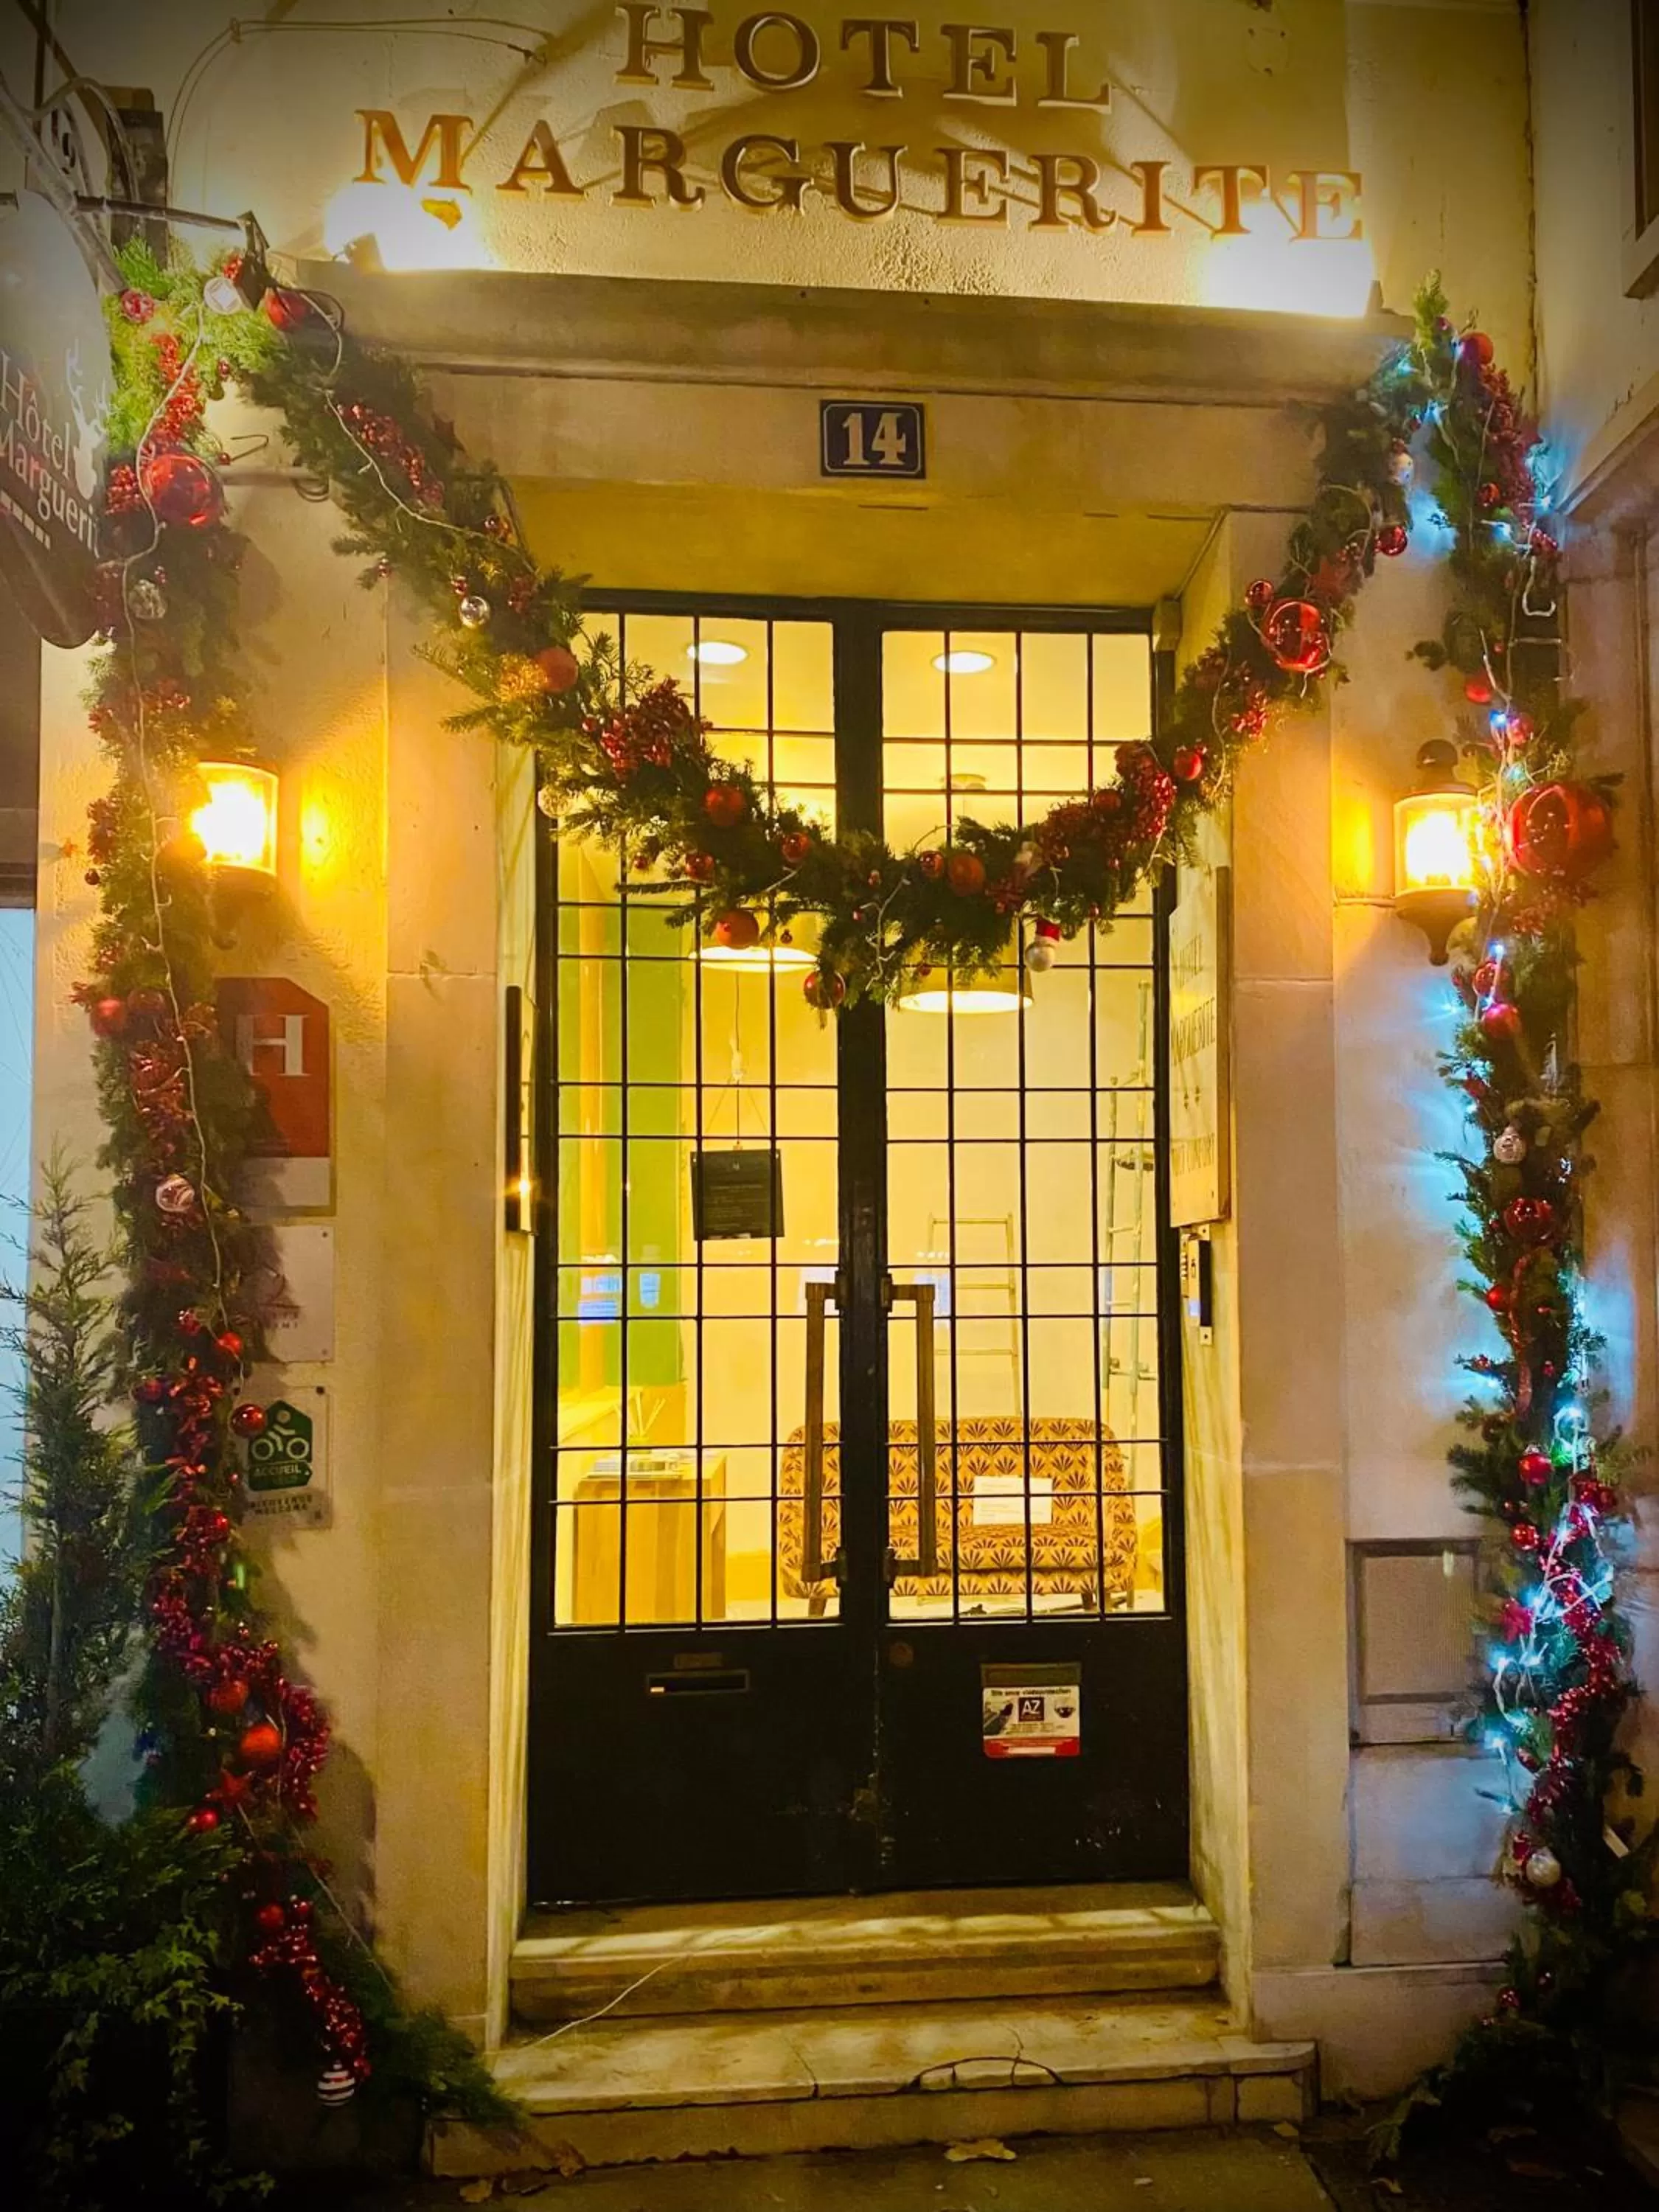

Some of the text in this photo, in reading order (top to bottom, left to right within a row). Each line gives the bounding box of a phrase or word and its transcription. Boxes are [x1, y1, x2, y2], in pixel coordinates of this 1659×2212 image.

[614, 3, 1111, 112] HOTEL
[352, 109, 1363, 240] MARGUERITE
[1, 350, 71, 479] Hôtel
[842, 412, 906, 465] 14
[0, 418, 100, 559] Marguerit
[234, 1014, 311, 1077] H
[1021, 1700, 1041, 1715] AZ
